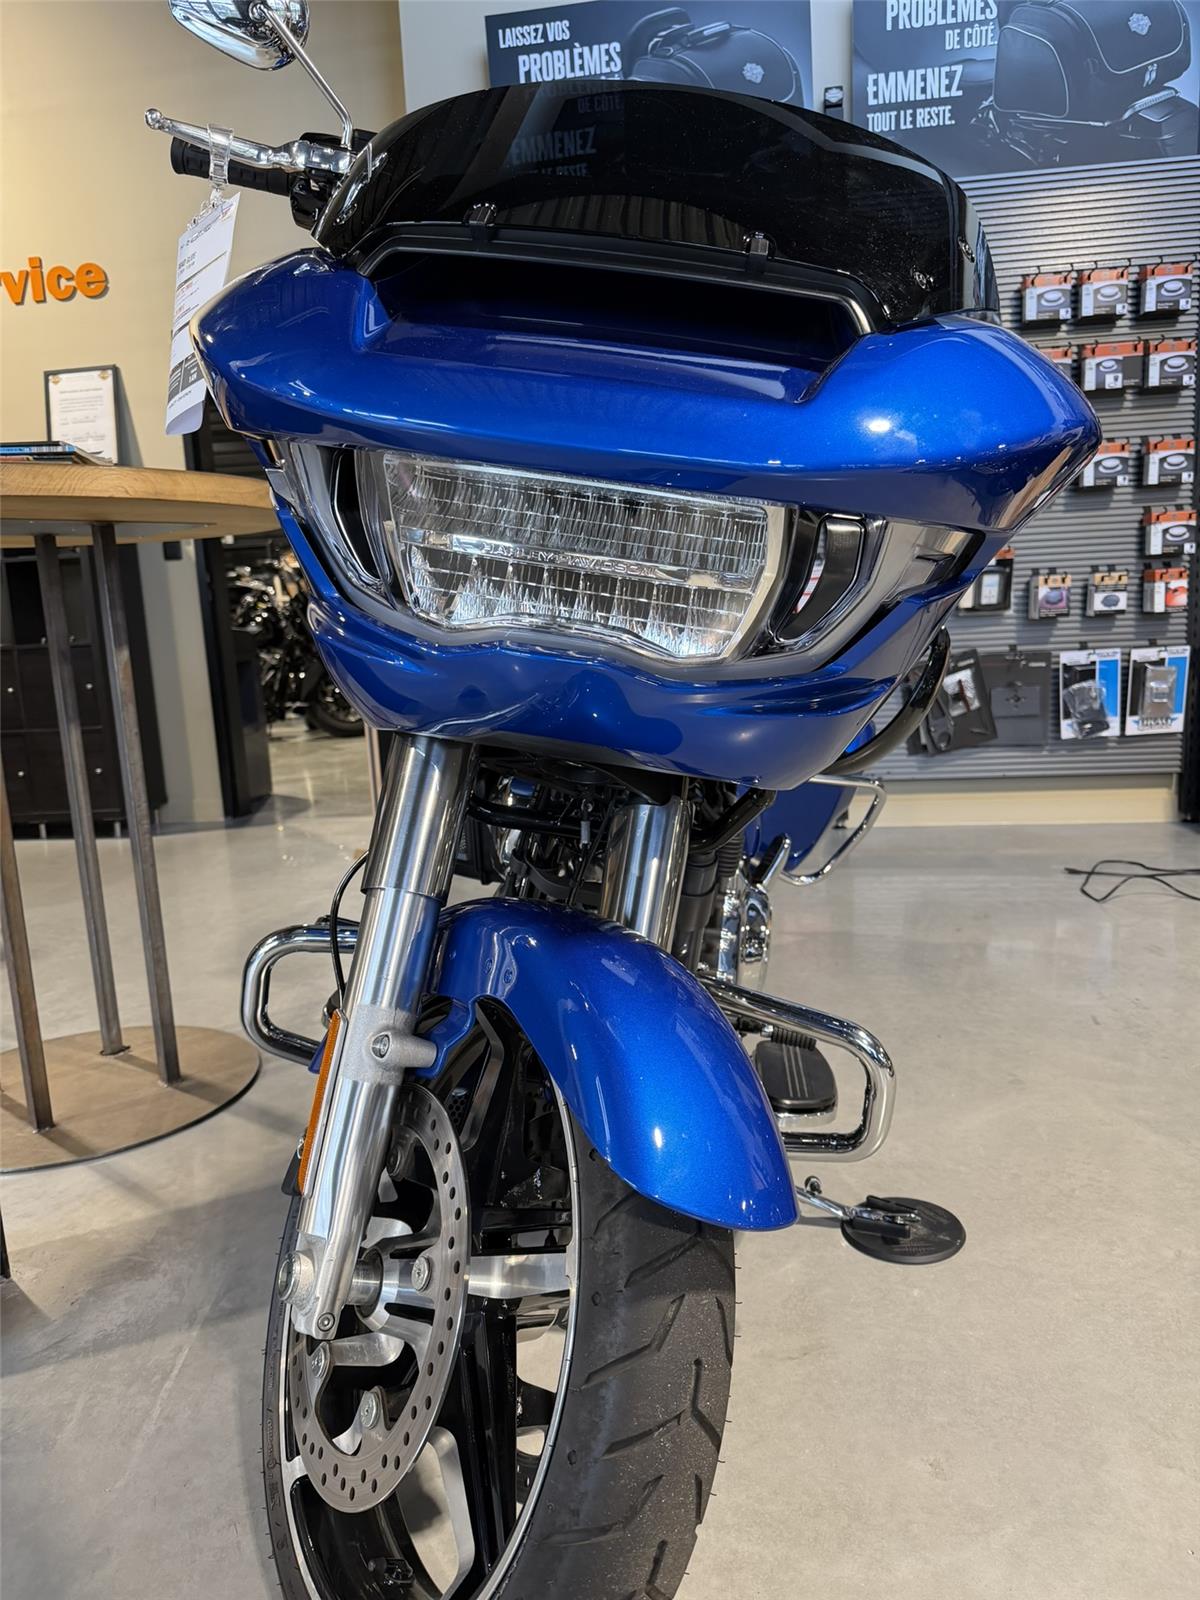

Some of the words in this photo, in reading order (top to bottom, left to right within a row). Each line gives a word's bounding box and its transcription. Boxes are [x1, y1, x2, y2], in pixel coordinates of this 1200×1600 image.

[498, 23, 545, 49] LAISSEZ
[546, 19, 571, 43] VOS
[945, 29, 961, 51] DE
[964, 22, 998, 48] CÔTÉ.
[517, 41, 622, 84] PROBLÈMES
[866, 65, 963, 106] EMMENEZ
[867, 111, 898, 133] TOUT
[900, 109, 914, 130] LE
[916, 105, 956, 129] RESTE.
[511, 126, 598, 167] EMMENEZ
[0, 257, 108, 305] vice
